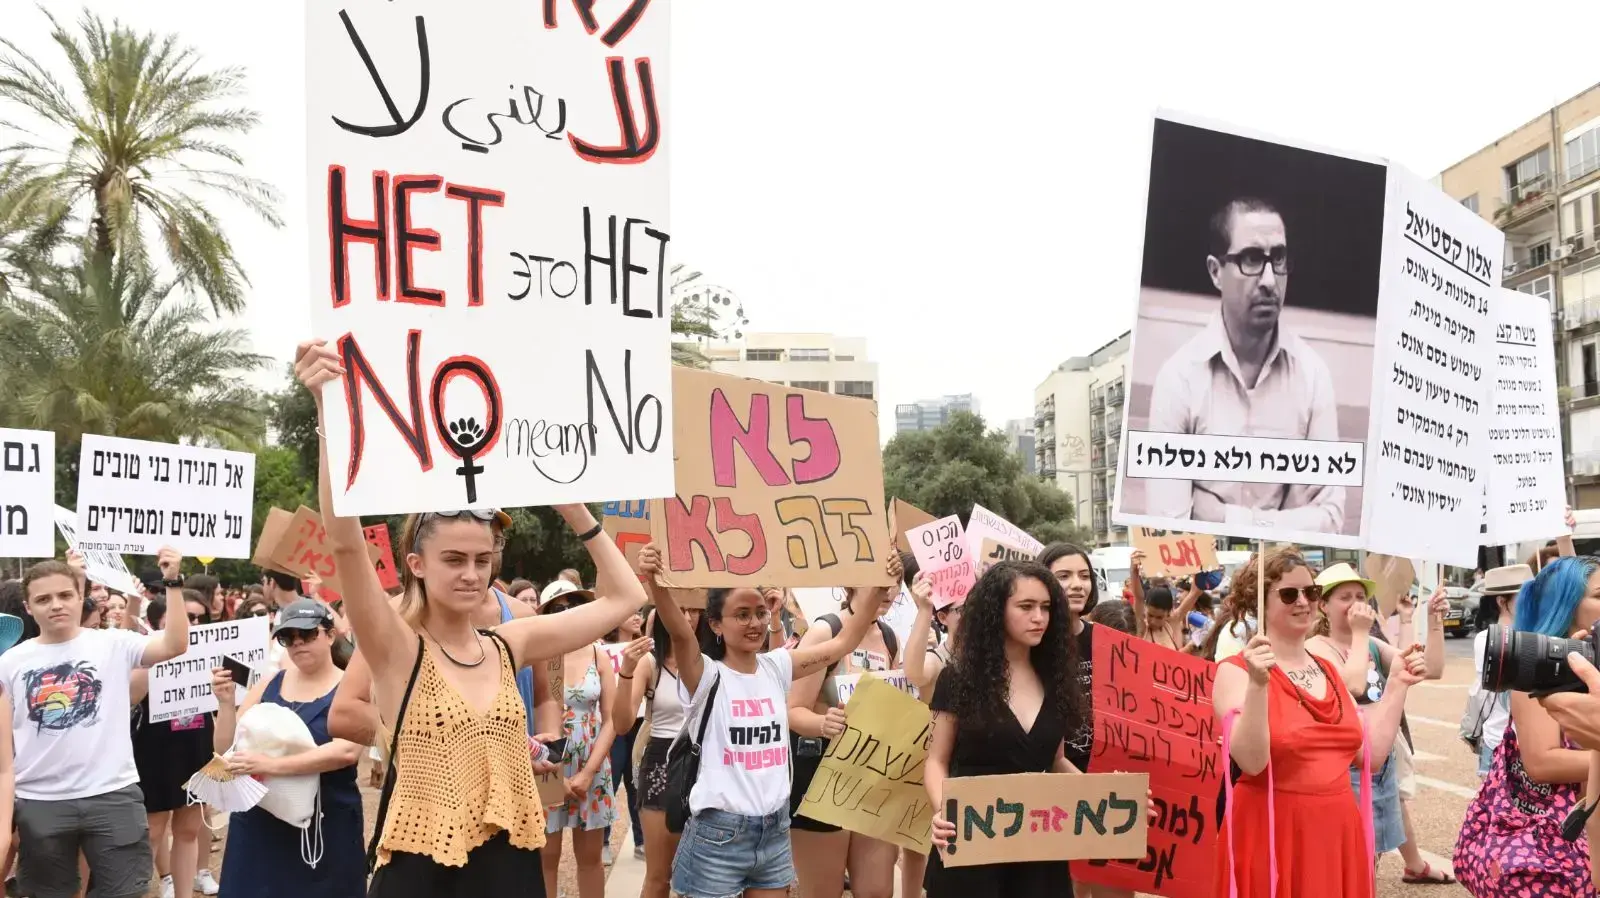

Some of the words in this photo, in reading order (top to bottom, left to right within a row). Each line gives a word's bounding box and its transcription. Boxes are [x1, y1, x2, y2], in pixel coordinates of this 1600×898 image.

[1406, 200, 1462, 264] קסטיאל
[1401, 257, 1428, 284] אונס,
[1466, 244, 1492, 281] אלון
[1432, 267, 1443, 292] על
[1445, 280, 1475, 310] תלונות
[1477, 297, 1488, 316] 14
[1409, 300, 1441, 328] מינית,
[1397, 331, 1424, 357] אונס.
[1444, 316, 1475, 345] תקיפה
[1426, 344, 1447, 367] בסם
[1450, 354, 1481, 381] שימוש
[1392, 361, 1423, 393] שכולל
[1425, 379, 1450, 404] טיעון
[1453, 392, 1479, 415] הסדר
[1397, 406, 1445, 438] מהמקרים
[1447, 423, 1453, 441] 4
[505, 417, 598, 484] means
[709, 387, 841, 488] לא
[1381, 440, 1401, 461] הוא
[1456, 429, 1469, 448] רק
[93, 450, 141, 480] טובים
[149, 455, 170, 483] בני
[1136, 442, 1206, 468] נסלח!
[1213, 446, 1252, 470] ולא
[1260, 452, 1320, 473] נשכח
[1327, 452, 1357, 475] לא
[1404, 447, 1434, 471] שבהם
[178, 458, 217, 487] תגידו
[224, 459, 244, 489] אל
[1437, 458, 1476, 483] שהחמור
[88, 505, 164, 535] ומטרידים
[171, 509, 217, 538] אנסים
[224, 510, 243, 539] על
[775, 495, 874, 569] זה
[922, 521, 958, 546] הכוס
[664, 494, 768, 576] לא
[940, 541, 963, 562] שלי
[156, 658, 206, 679] הרדיקלית
[248, 648, 264, 662] היא
[1110, 638, 1139, 682] לא
[160, 688, 186, 704] אדם.
[732, 697, 775, 717] רוצה
[1103, 684, 1138, 713] מה
[729, 721, 782, 745] להיות
[1145, 696, 1214, 749] אכפת
[1094, 718, 1172, 767] לובשת
[1181, 748, 1217, 783] אני
[946, 797, 1024, 855] לא!
[1030, 806, 1069, 833] זה
[1074, 791, 1138, 836] לא
[1149, 795, 1205, 845] למה
